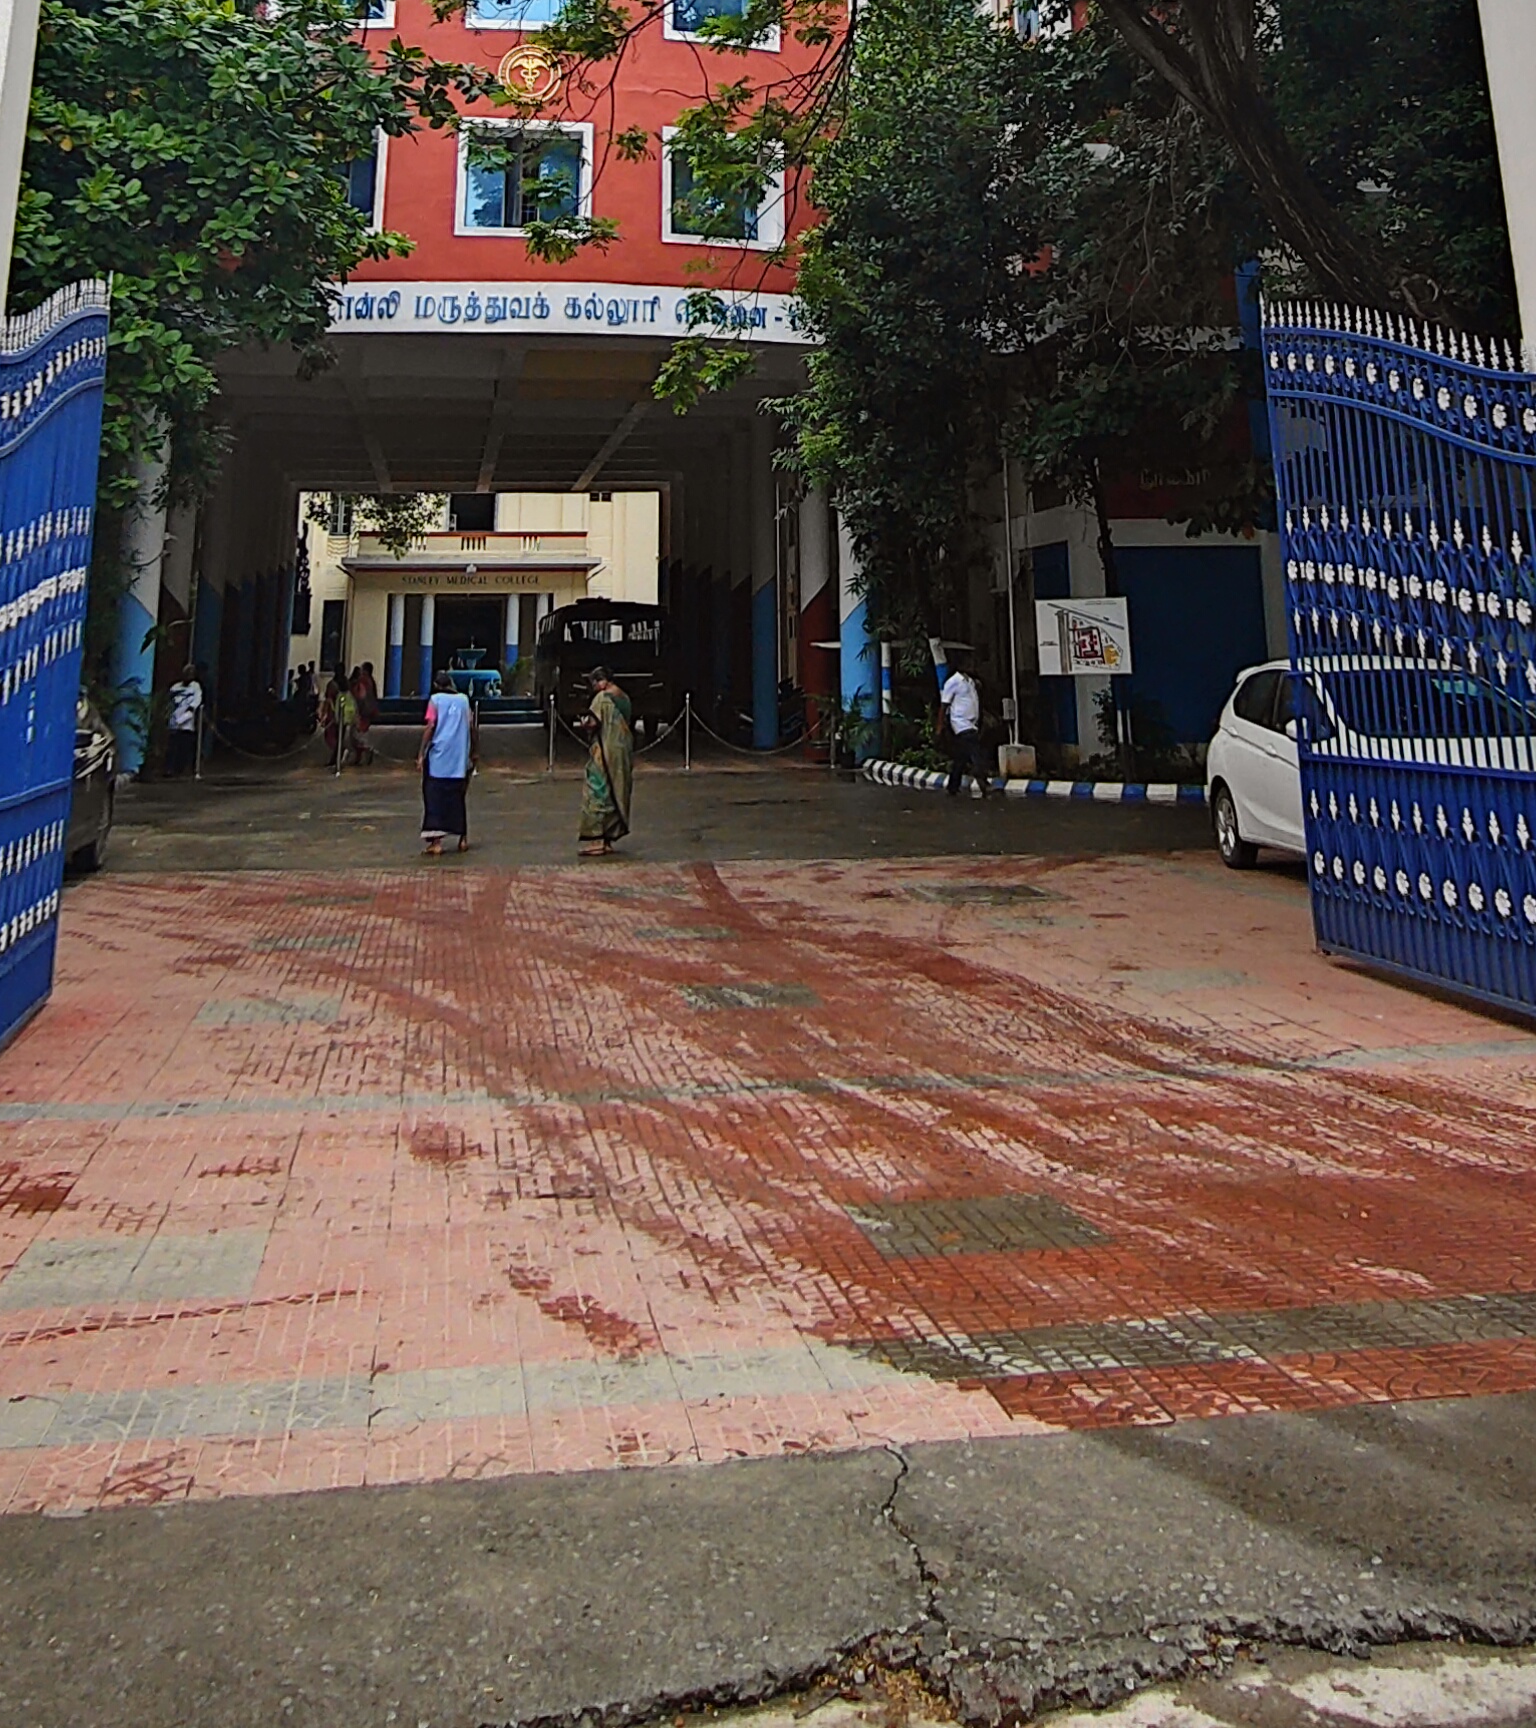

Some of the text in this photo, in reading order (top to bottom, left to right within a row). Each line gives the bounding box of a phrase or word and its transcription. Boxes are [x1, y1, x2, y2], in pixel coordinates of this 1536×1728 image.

[414, 290, 550, 324] மருத்துவக்
[564, 291, 662, 326] கல்லூரி
[446, 575, 489, 585] MEDICAL
[495, 575, 540, 585] COLLEGE
